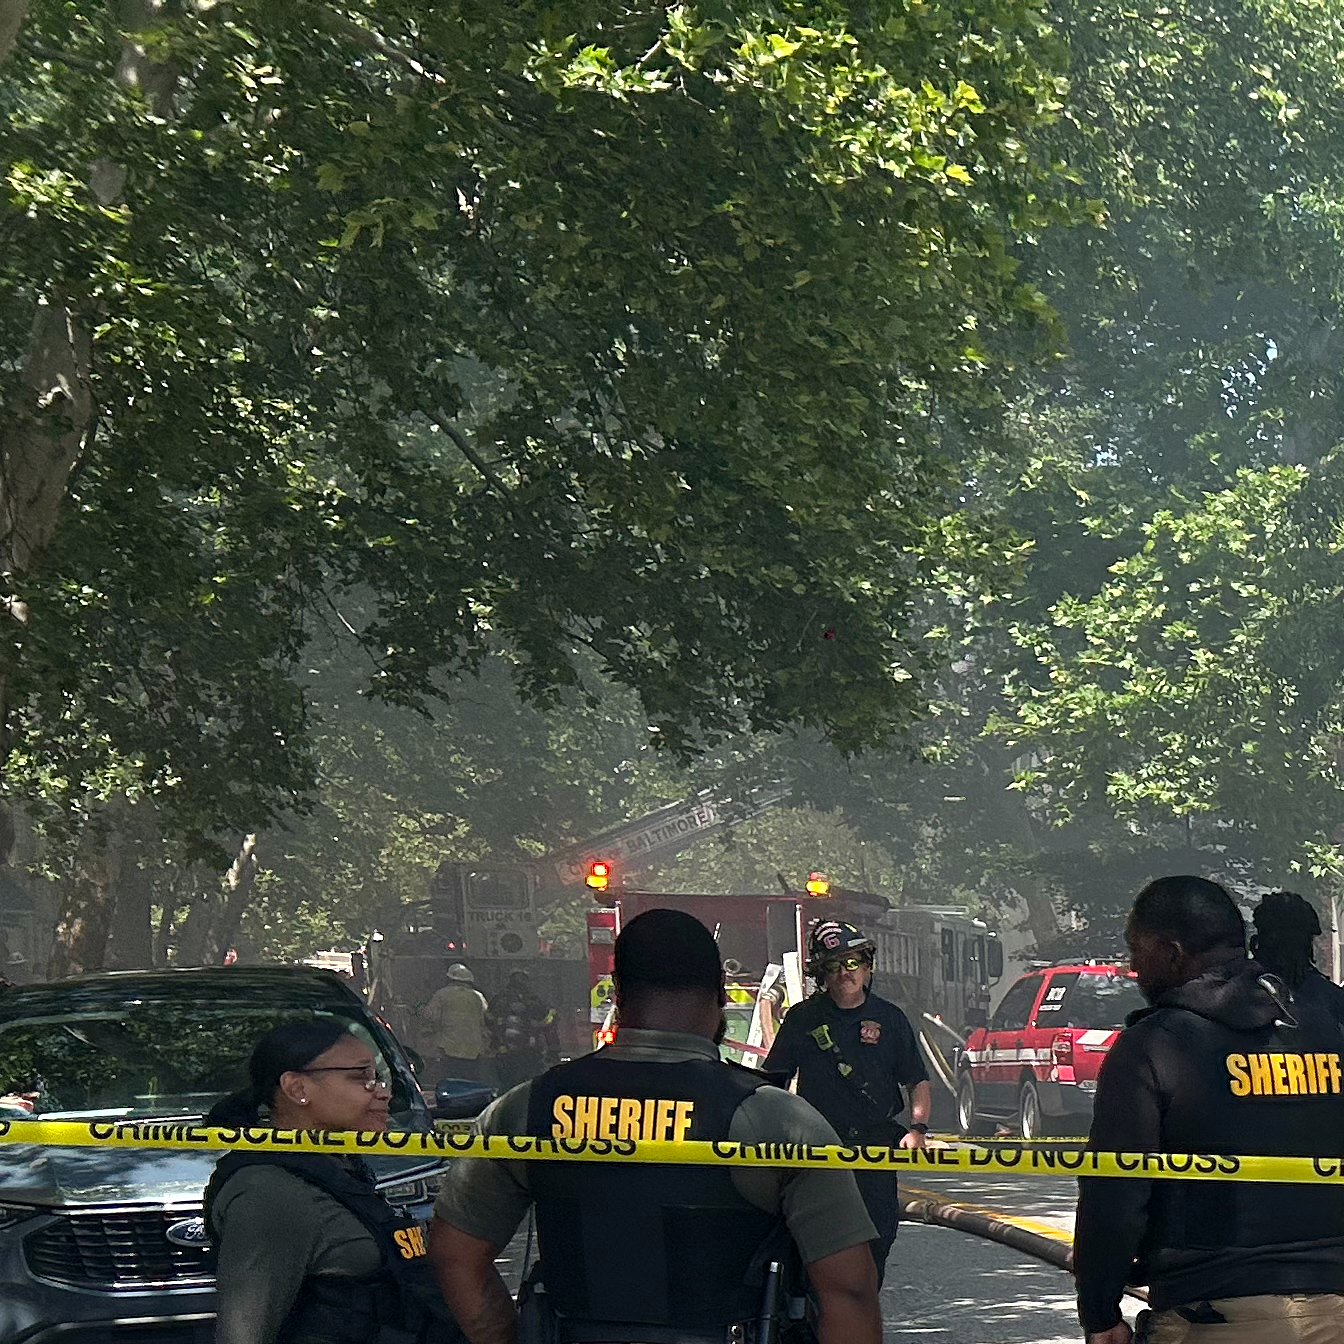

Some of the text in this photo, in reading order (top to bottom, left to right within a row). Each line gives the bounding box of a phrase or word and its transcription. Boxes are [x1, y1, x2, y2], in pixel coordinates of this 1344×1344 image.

[626, 808, 710, 853] BALTIMORE
[467, 911, 513, 922] TRUCK
[1226, 1053, 1342, 1097] SHERIFF
[89, 1121, 637, 1156] CRIME SCENE DO NOT CROSS
[551, 1095, 694, 1143] SHERIFF
[711, 1140, 1241, 1174] CRIME SCENE DO NOT CROSS
